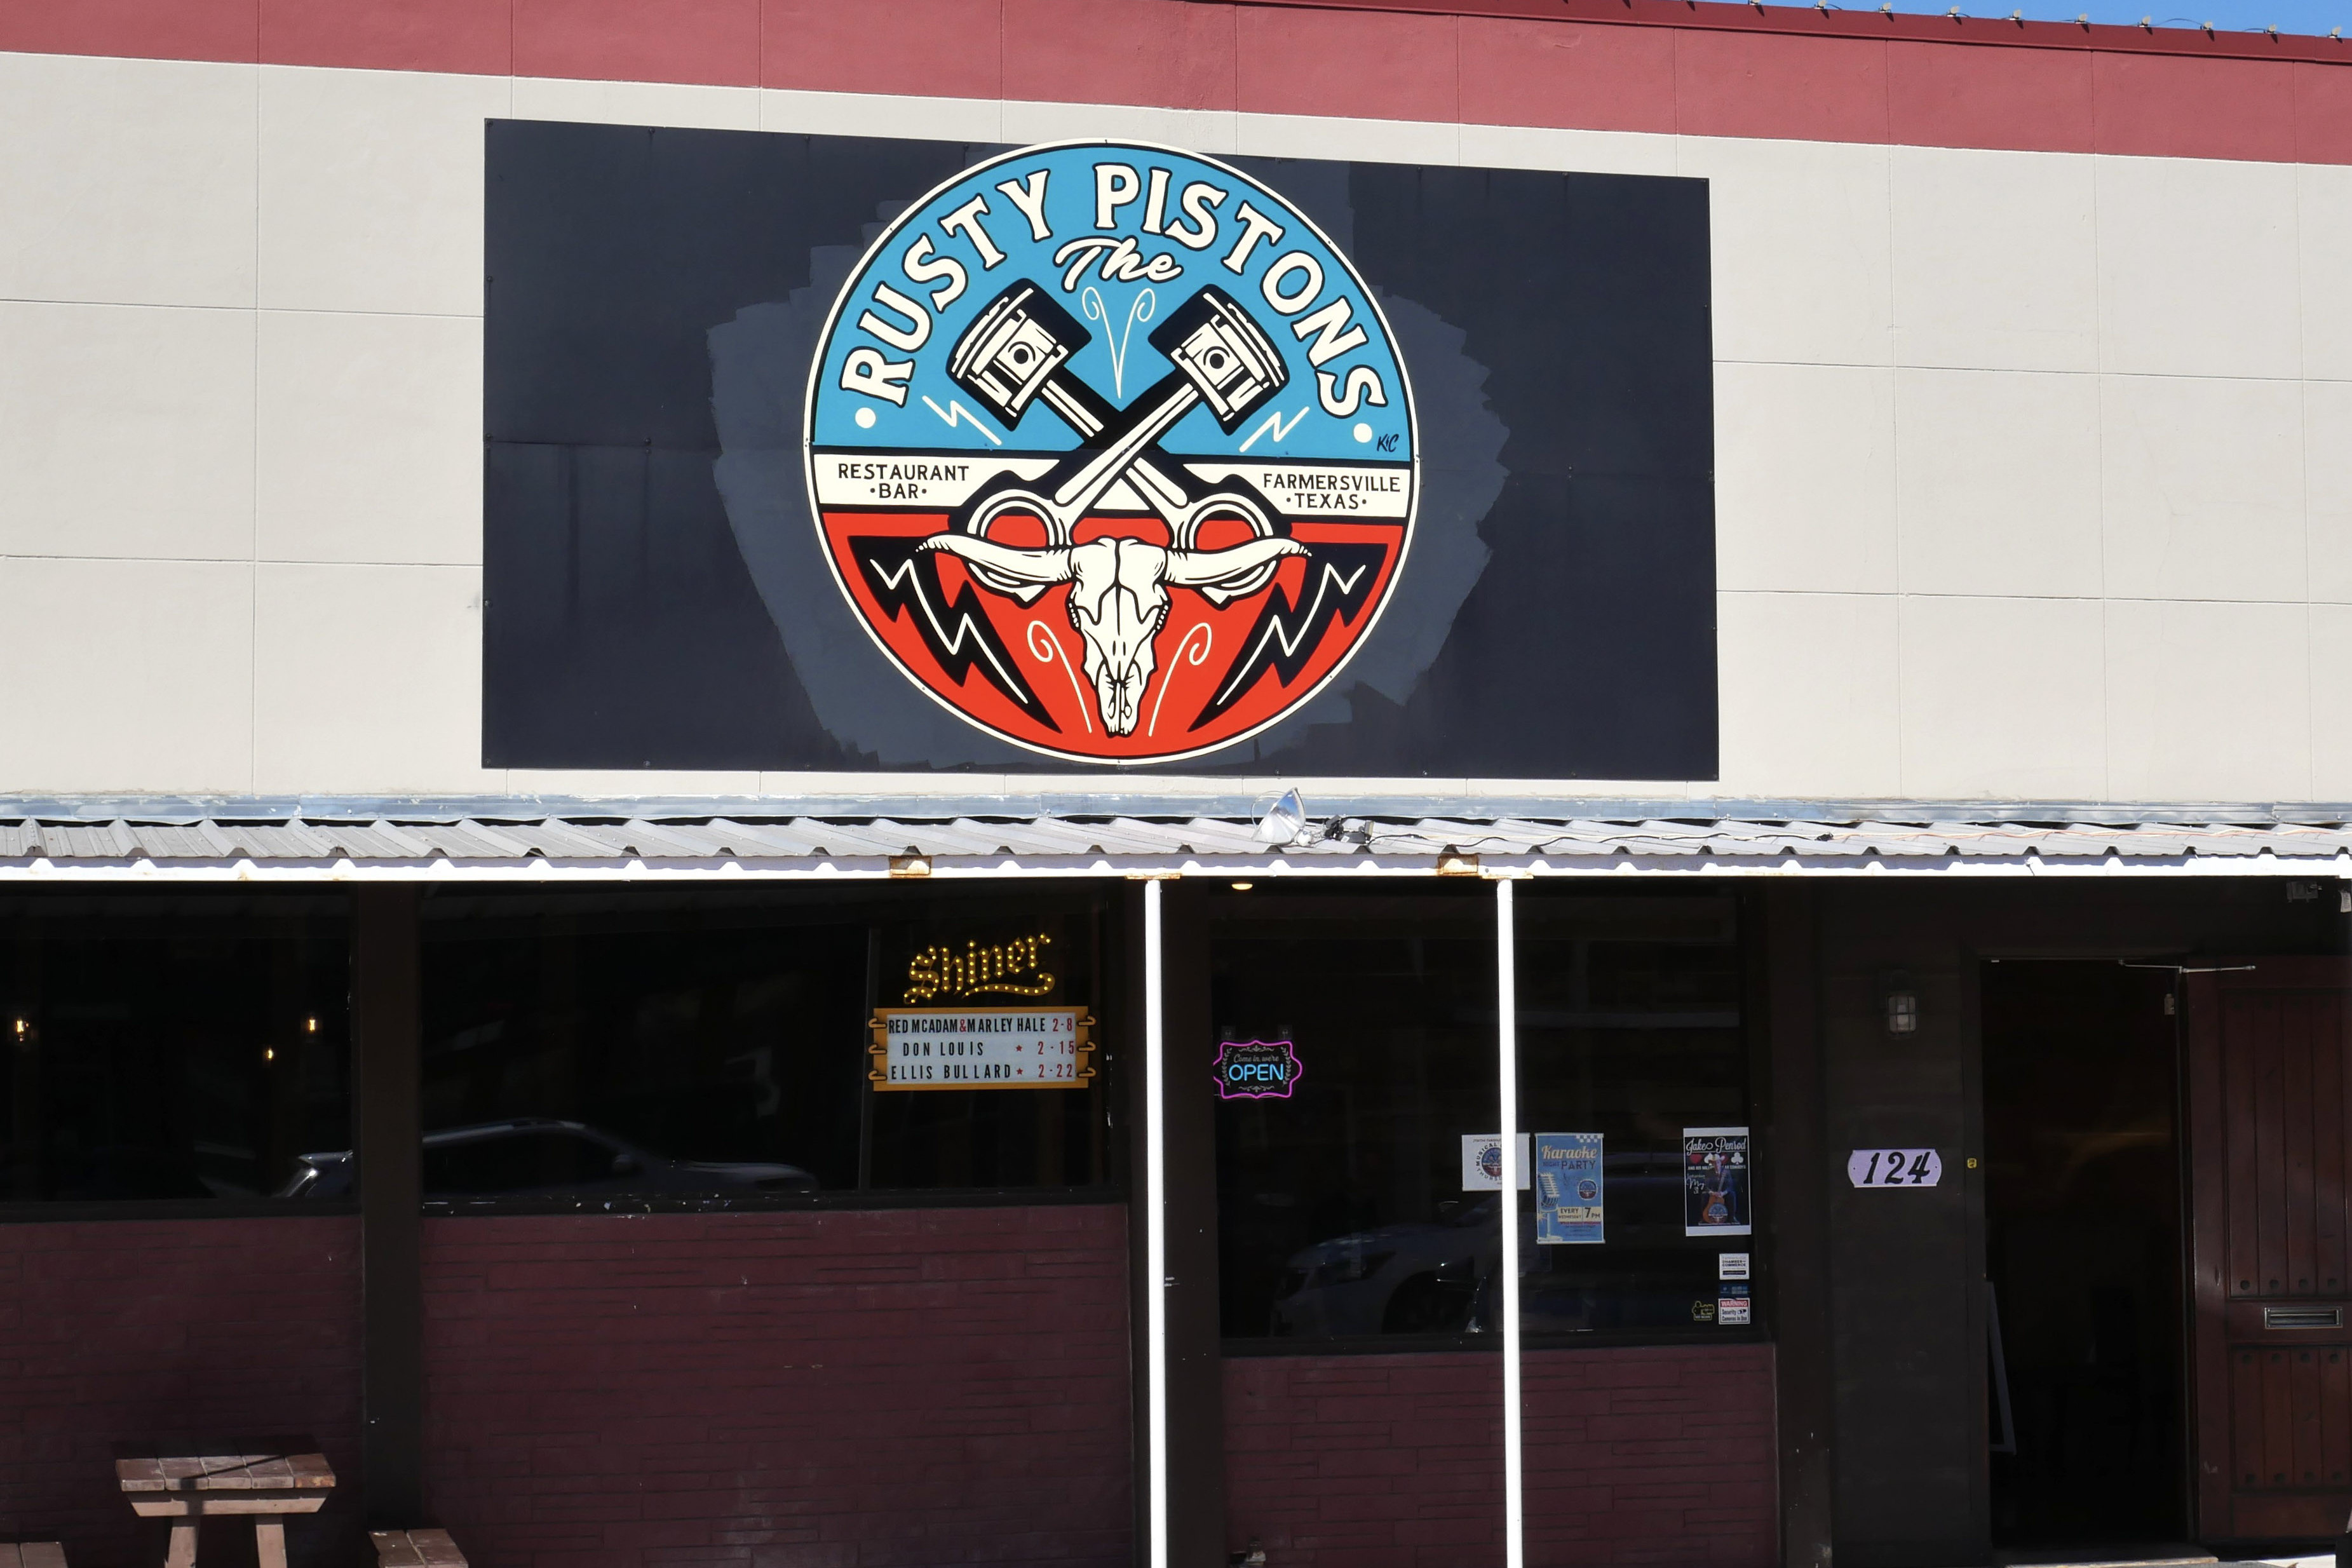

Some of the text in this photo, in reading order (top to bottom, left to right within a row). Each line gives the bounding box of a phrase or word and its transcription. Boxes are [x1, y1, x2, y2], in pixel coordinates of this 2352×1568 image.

[1053, 236, 1183, 292] The
[839, 162, 1389, 419] RUSTY PISTONS
[839, 463, 970, 481] RESTAURANT
[1263, 473, 1400, 492] FARMERSVILLE
[904, 932, 1052, 1004] Shiner
[889, 1019, 909, 1034] RED
[1017, 1017, 1046, 1032] HALE
[903, 1042, 931, 1057] DON
[940, 1041, 984, 1056] LOUIS
[1233, 1053, 1252, 1063] Come
[891, 1065, 933, 1080] ELLIS
[943, 1064, 1011, 1079] BULLARD
[1229, 1064, 1284, 1081] OPEN
[1476, 1142, 1498, 1167] MUSICAL
[1541, 1146, 1598, 1159] Karaoke
[1686, 1137, 1747, 1156] Jake Penrod
[1561, 1160, 1596, 1170] PARTY
[1863, 1151, 1931, 1184] 124
[1585, 1207, 1591, 1218] 7
